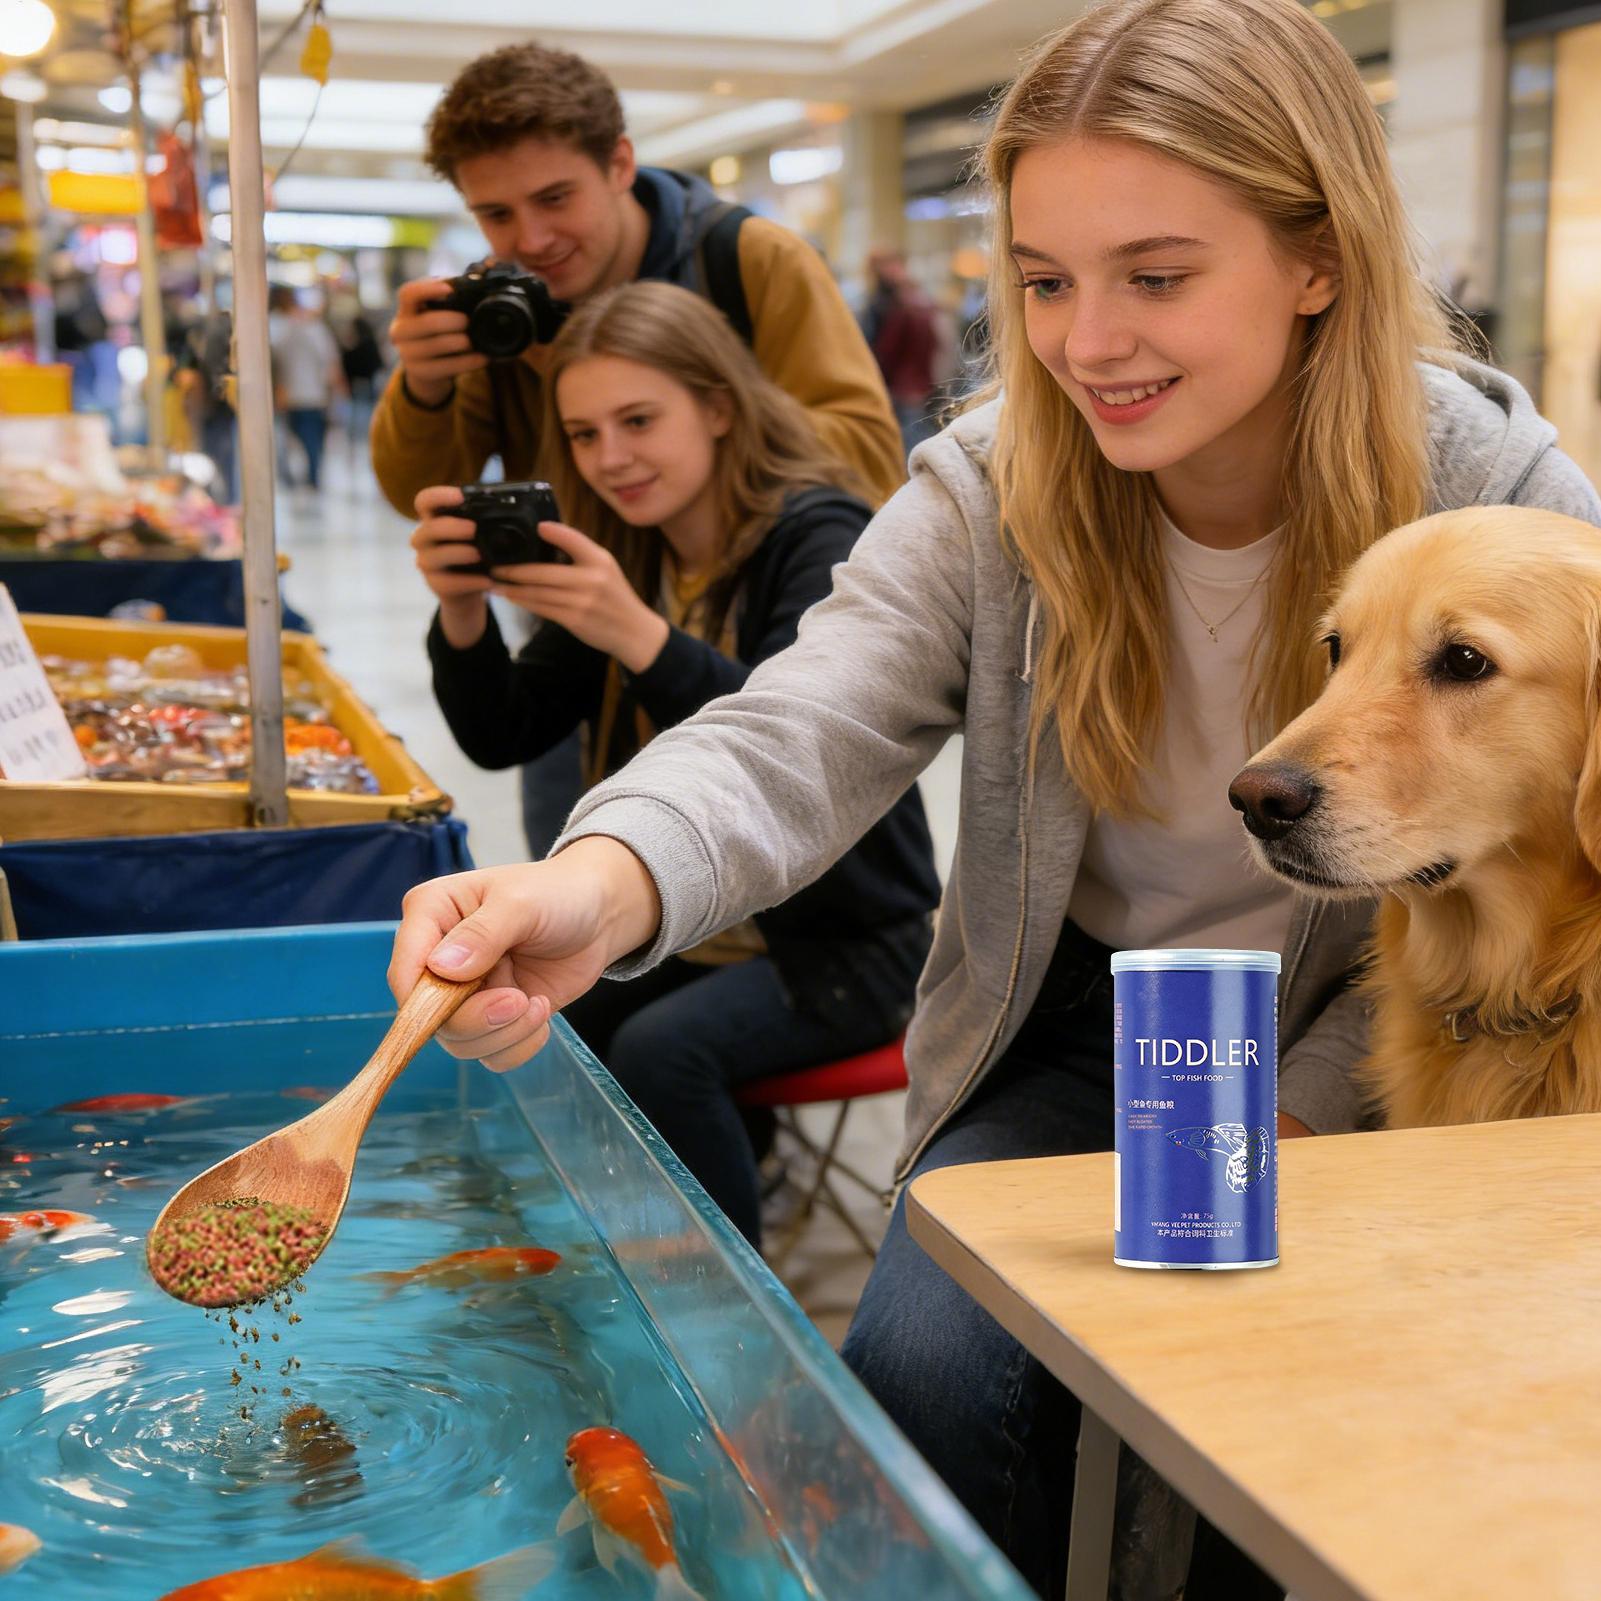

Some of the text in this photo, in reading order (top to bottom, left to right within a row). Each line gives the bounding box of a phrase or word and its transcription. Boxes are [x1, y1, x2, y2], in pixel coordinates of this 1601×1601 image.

[1135, 1038, 1259, 1066] TIDDLER
[1172, 1074, 1224, 1082] TOP FISH FOOD
